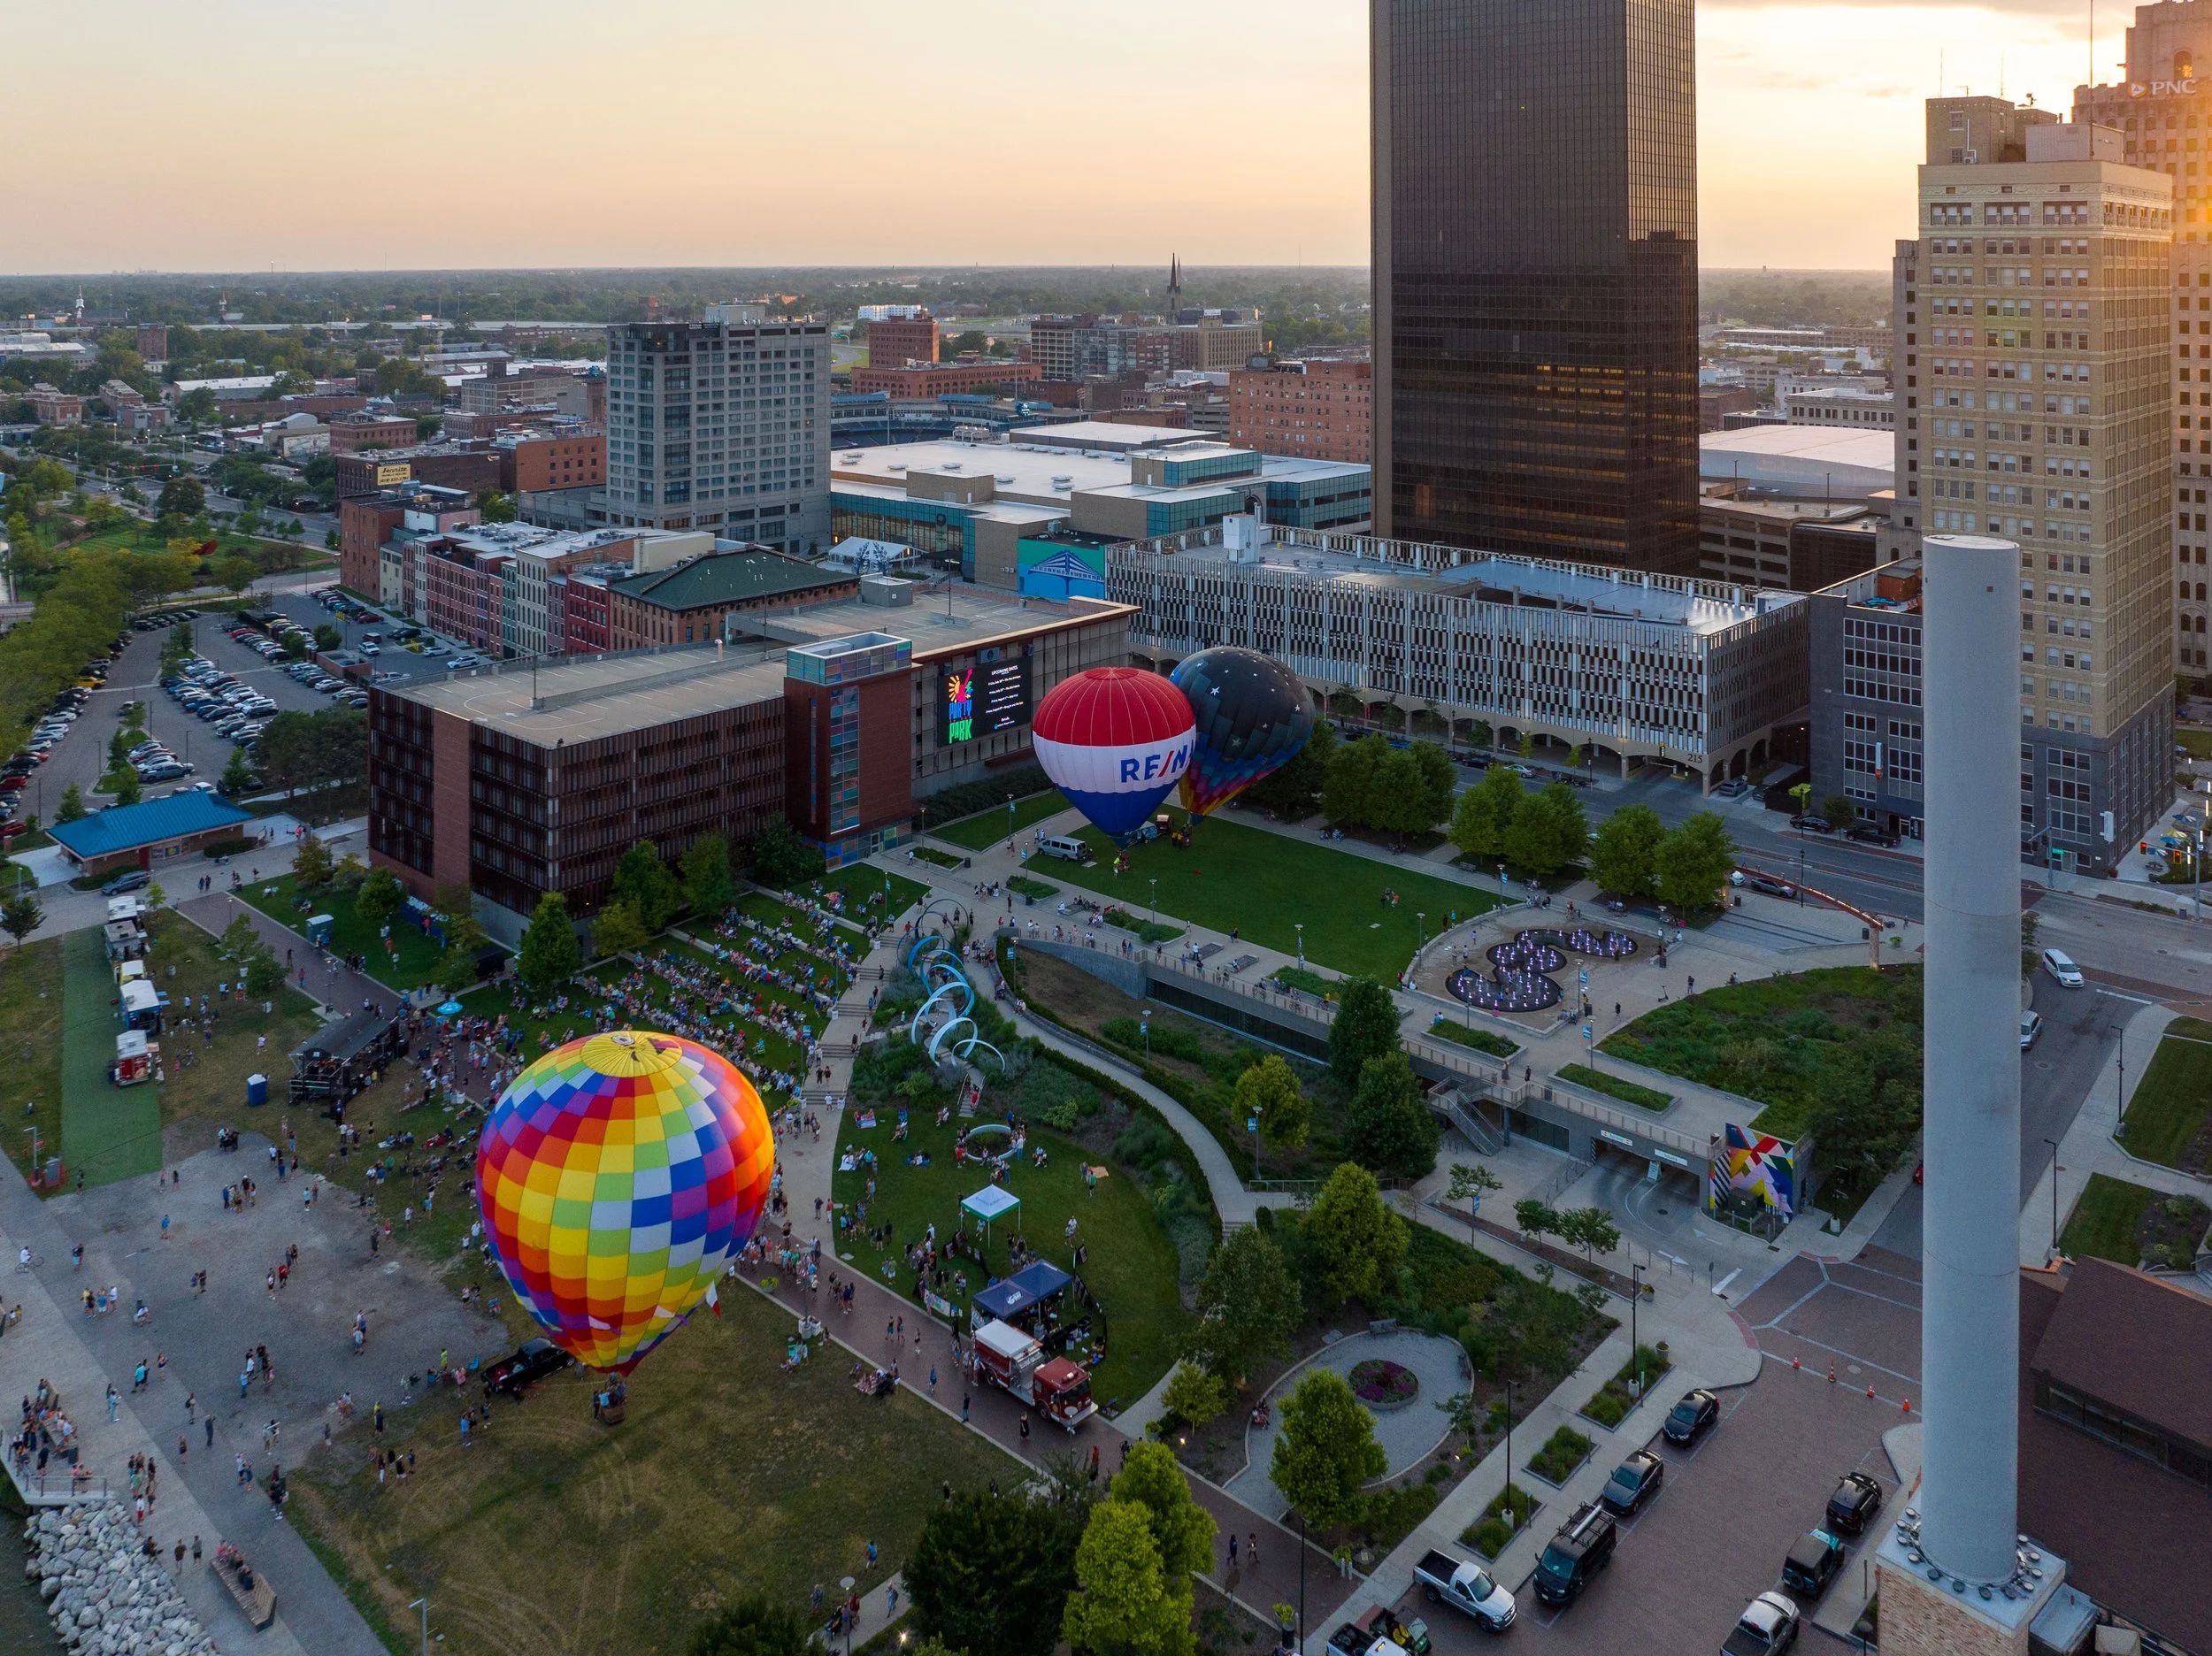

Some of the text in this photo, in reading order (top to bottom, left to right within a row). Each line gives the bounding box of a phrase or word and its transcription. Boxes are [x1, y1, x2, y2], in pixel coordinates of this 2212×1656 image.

[2150, 79, 2197, 96] PNC
[949, 699, 972, 720] PARTY
[949, 718, 972, 744] PARK
[1687, 754, 1702, 763] 215
